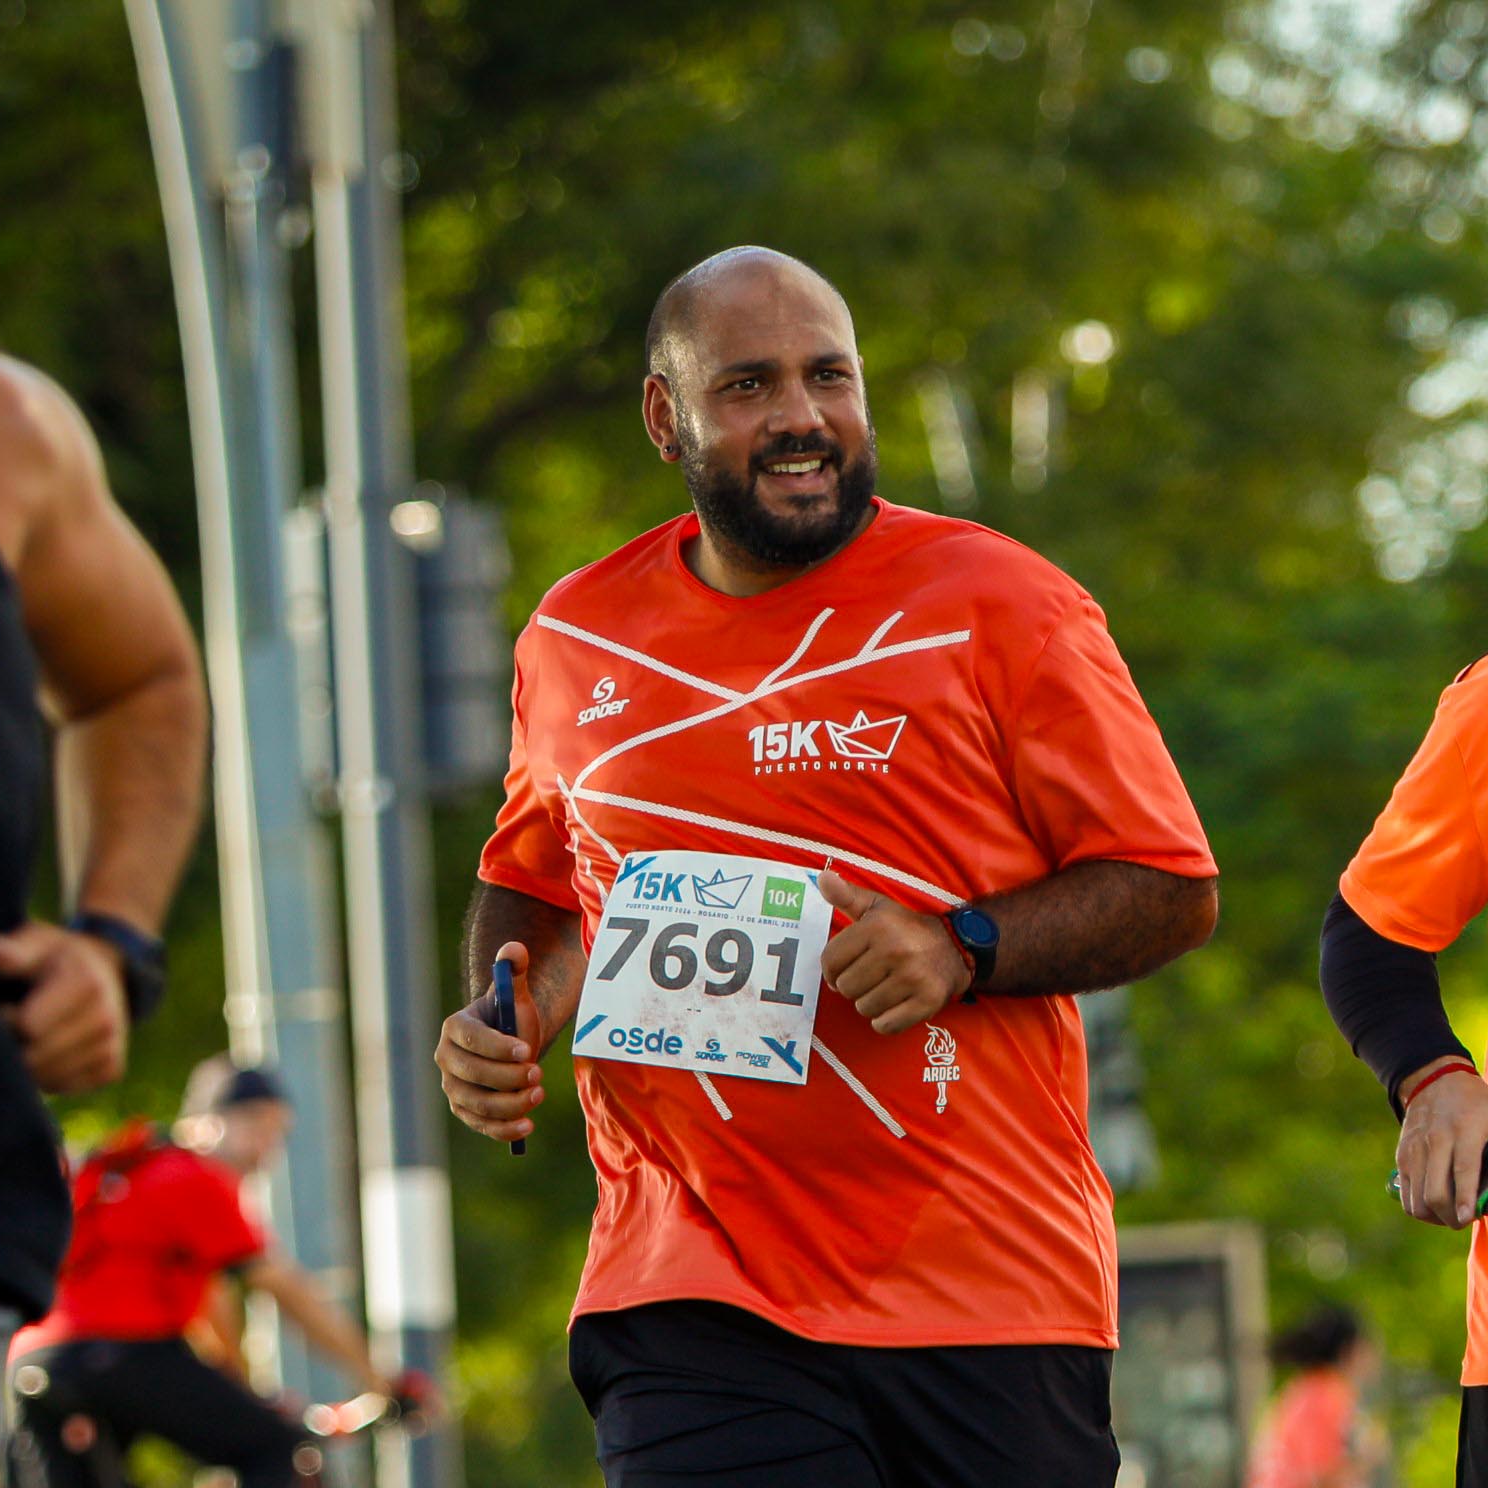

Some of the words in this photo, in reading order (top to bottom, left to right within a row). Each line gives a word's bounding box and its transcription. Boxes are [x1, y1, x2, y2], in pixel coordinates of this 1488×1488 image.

[748, 720, 823, 762] 15K
[754, 760, 821, 776] PUERTO
[829, 761, 889, 774] NORTE
[632, 871, 688, 903] 15K
[767, 888, 800, 908] 10K
[595, 917, 805, 1007] 7691
[608, 1026, 683, 1055] osde
[922, 1066, 960, 1082] ARDEC
